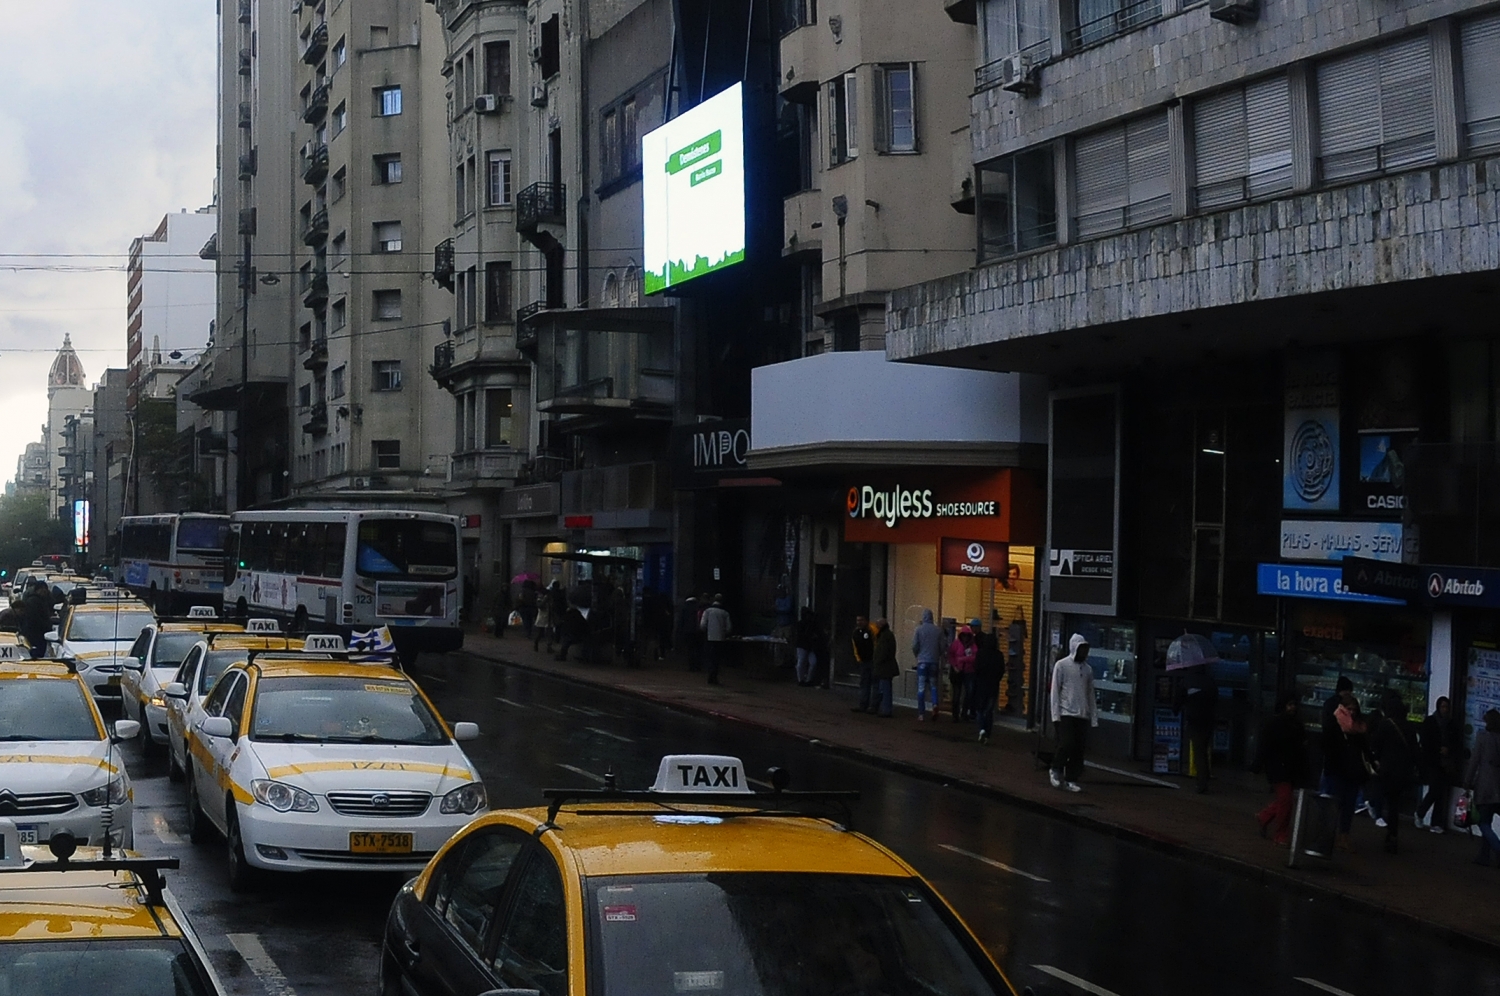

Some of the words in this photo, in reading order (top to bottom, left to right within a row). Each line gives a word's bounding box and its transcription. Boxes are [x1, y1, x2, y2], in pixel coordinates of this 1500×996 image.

[862, 484, 933, 528] Payless
[936, 501, 995, 516] SHOESOURCE
[1282, 532, 1311, 549] PILAS
[1320, 534, 1362, 551] MALLAS
[961, 563, 990, 573] Payless
[1277, 570, 1290, 589] la
[1295, 571, 1328, 593] hora
[1444, 578, 1485, 597] Abitab
[356, 595, 372, 605] 123
[252, 622, 275, 632] TAXI
[313, 638, 339, 649] TAXI
[677, 765, 738, 787] TAXI
[20, 832, 34, 842] 85
